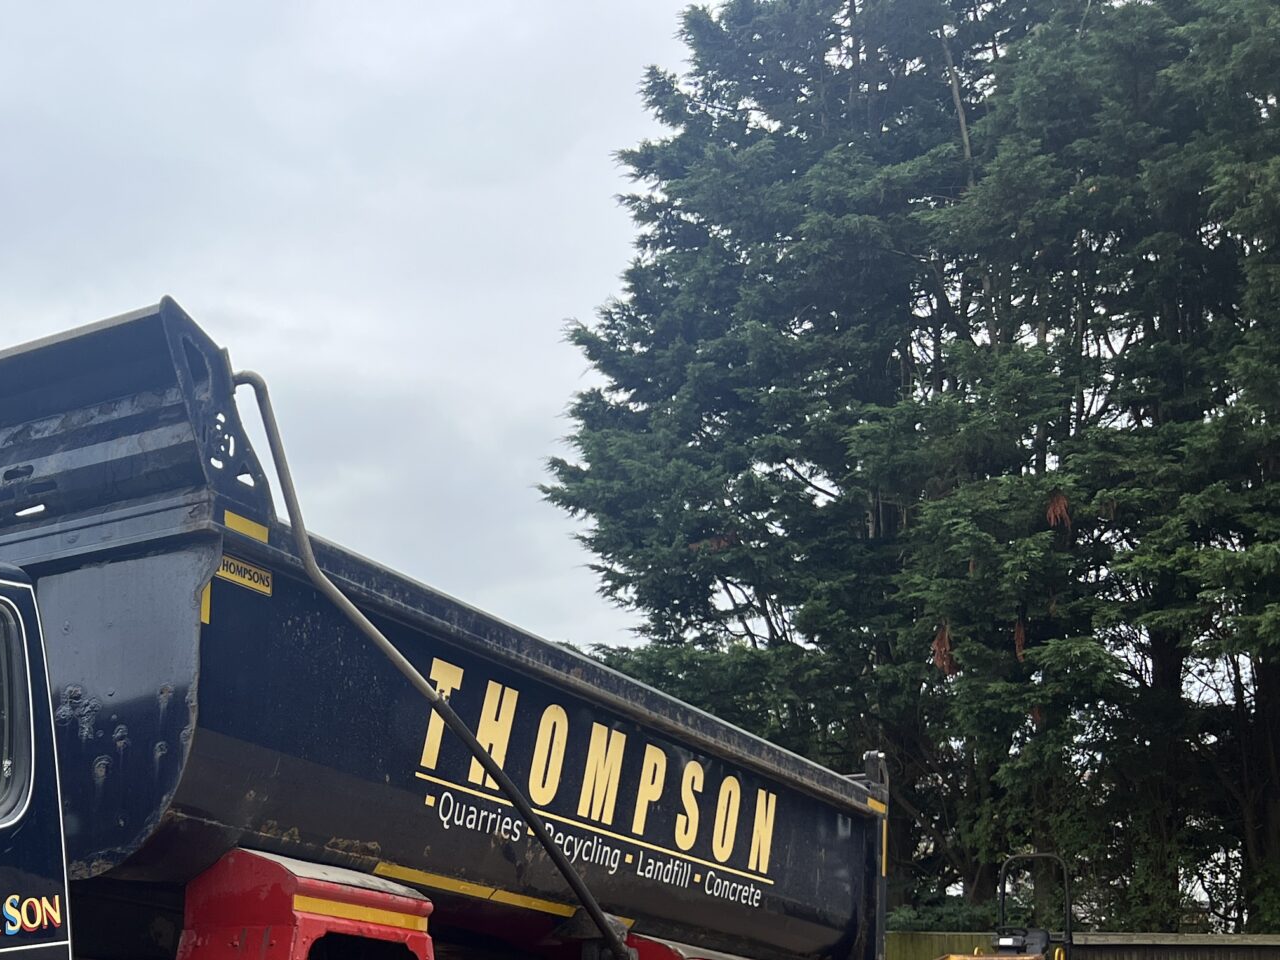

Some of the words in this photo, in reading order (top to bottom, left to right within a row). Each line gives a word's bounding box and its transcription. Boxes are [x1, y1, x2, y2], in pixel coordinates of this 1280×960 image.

[419, 657, 777, 874] THOMPSON
[438, 791, 522, 842] Quarries
[637, 851, 691, 889] Landfill
[705, 870, 762, 908] Concrete
[2, 894, 62, 937] SON
